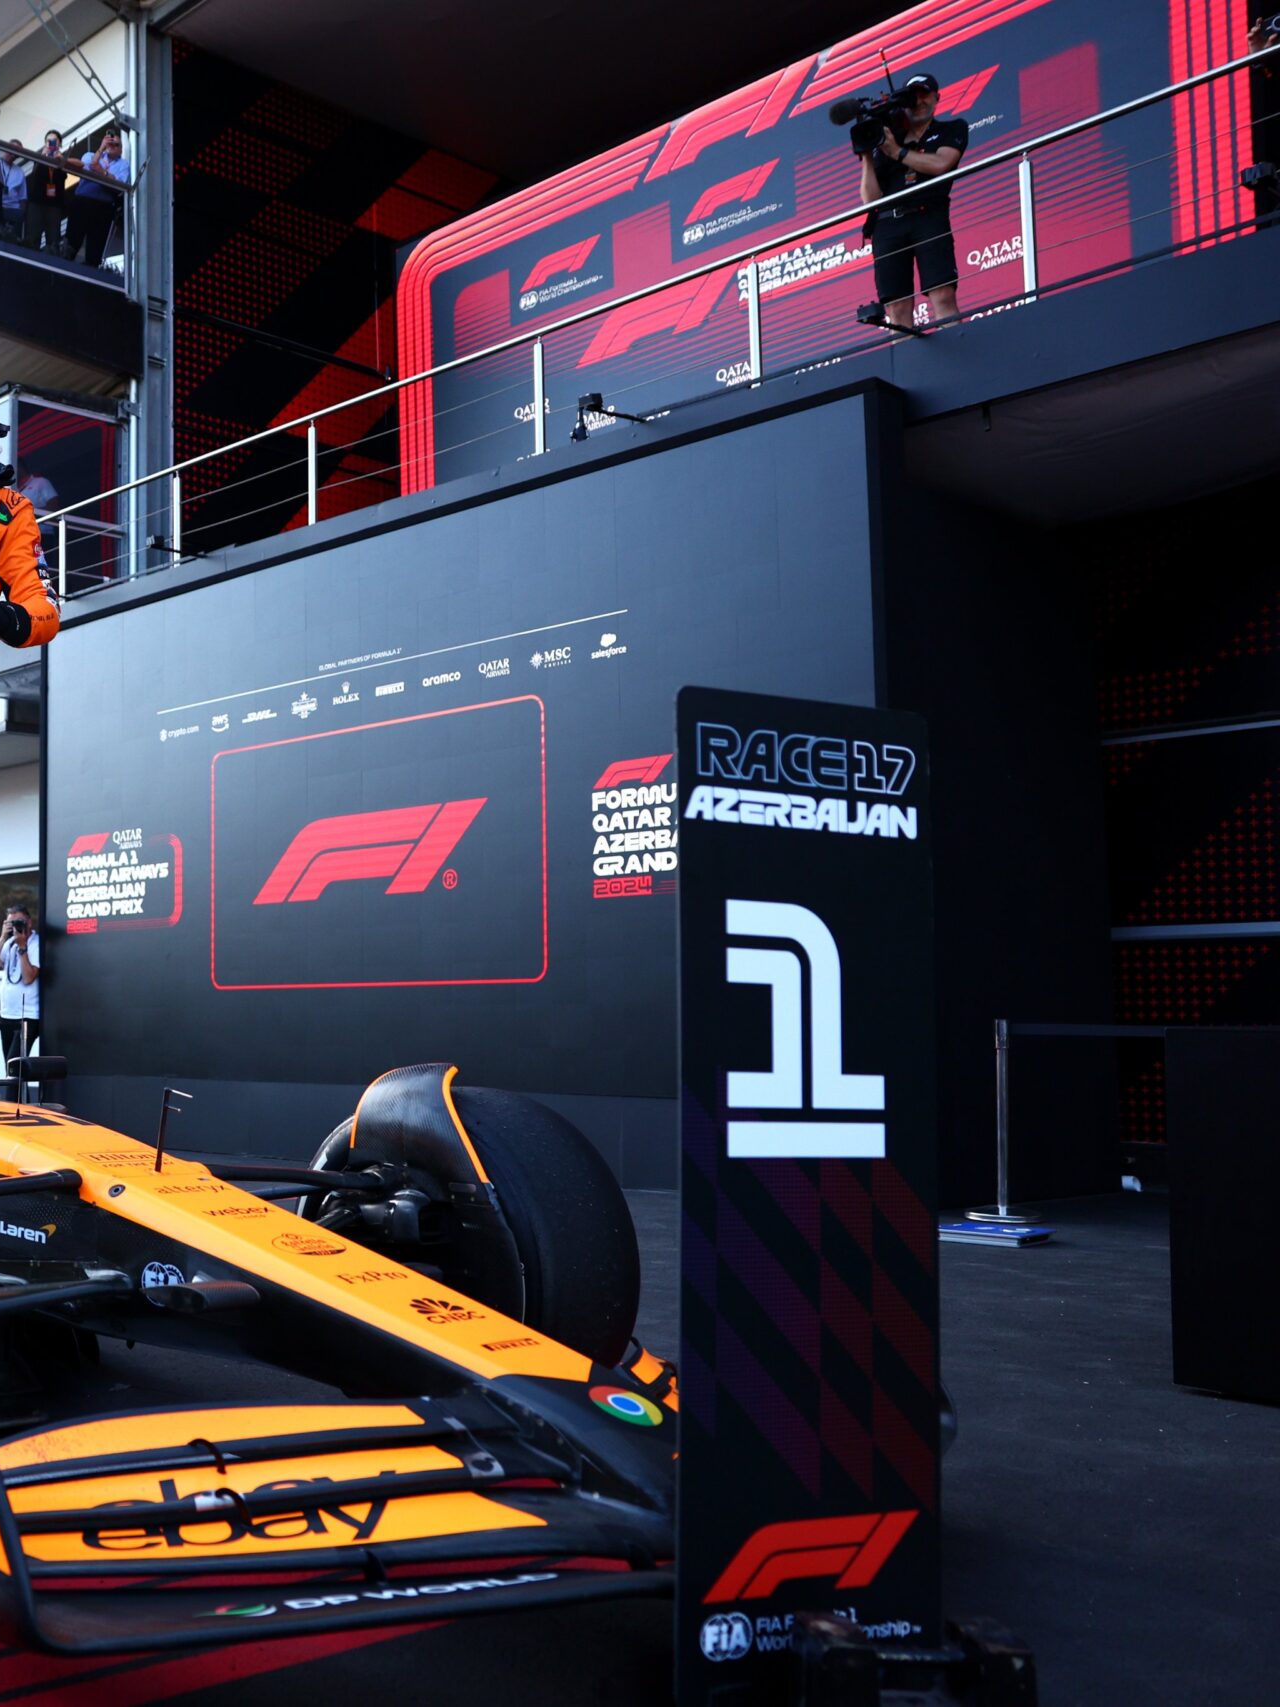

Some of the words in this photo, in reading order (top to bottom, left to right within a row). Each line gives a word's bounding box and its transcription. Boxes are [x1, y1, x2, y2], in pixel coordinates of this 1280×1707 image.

[784, 242, 845, 274] AIRWAYS
[823, 244, 873, 269] GRAND
[967, 235, 1023, 266] QATAR
[319, 662, 337, 672] GLOBAL
[338, 655, 363, 667] PARTNERS
[371, 649, 397, 660] FORMULA
[544, 647, 572, 662] MSC
[591, 645, 627, 660] salesforce
[478, 657, 510, 674] QATAR
[422, 671, 461, 688] aramco
[332, 692, 360, 706] ROLEX
[168, 725, 199, 738] crypto.com
[696, 721, 849, 791] RACE
[852, 740, 917, 796] 17
[591, 783, 677, 812] FORMU
[592, 806, 672, 833] QATAR
[684, 784, 918, 840] AZERBAIJAN
[112, 828, 142, 844] QATAR
[67, 852, 129, 872] FORMULA
[130, 850, 139, 865] 1
[593, 851, 678, 877] GRAND
[67, 870, 109, 887] QATAR
[109, 862, 169, 883] AIRWAYS
[67, 881, 146, 904] AZERBAIJAN
[593, 876, 652, 898] 2024
[67, 901, 111, 919] GRAND
[112, 898, 144, 915] PRIX
[726, 898, 885, 1158] 1
[89, 1152, 155, 1162] Hilton
[203, 1206, 274, 1217] webex
[336, 1271, 408, 1284] FxPro
[427, 1311, 486, 1324] CNBC
[284, 1594, 359, 1609] DP
[363, 1573, 559, 1599] WORLD
[756, 1616, 782, 1633] FIA
